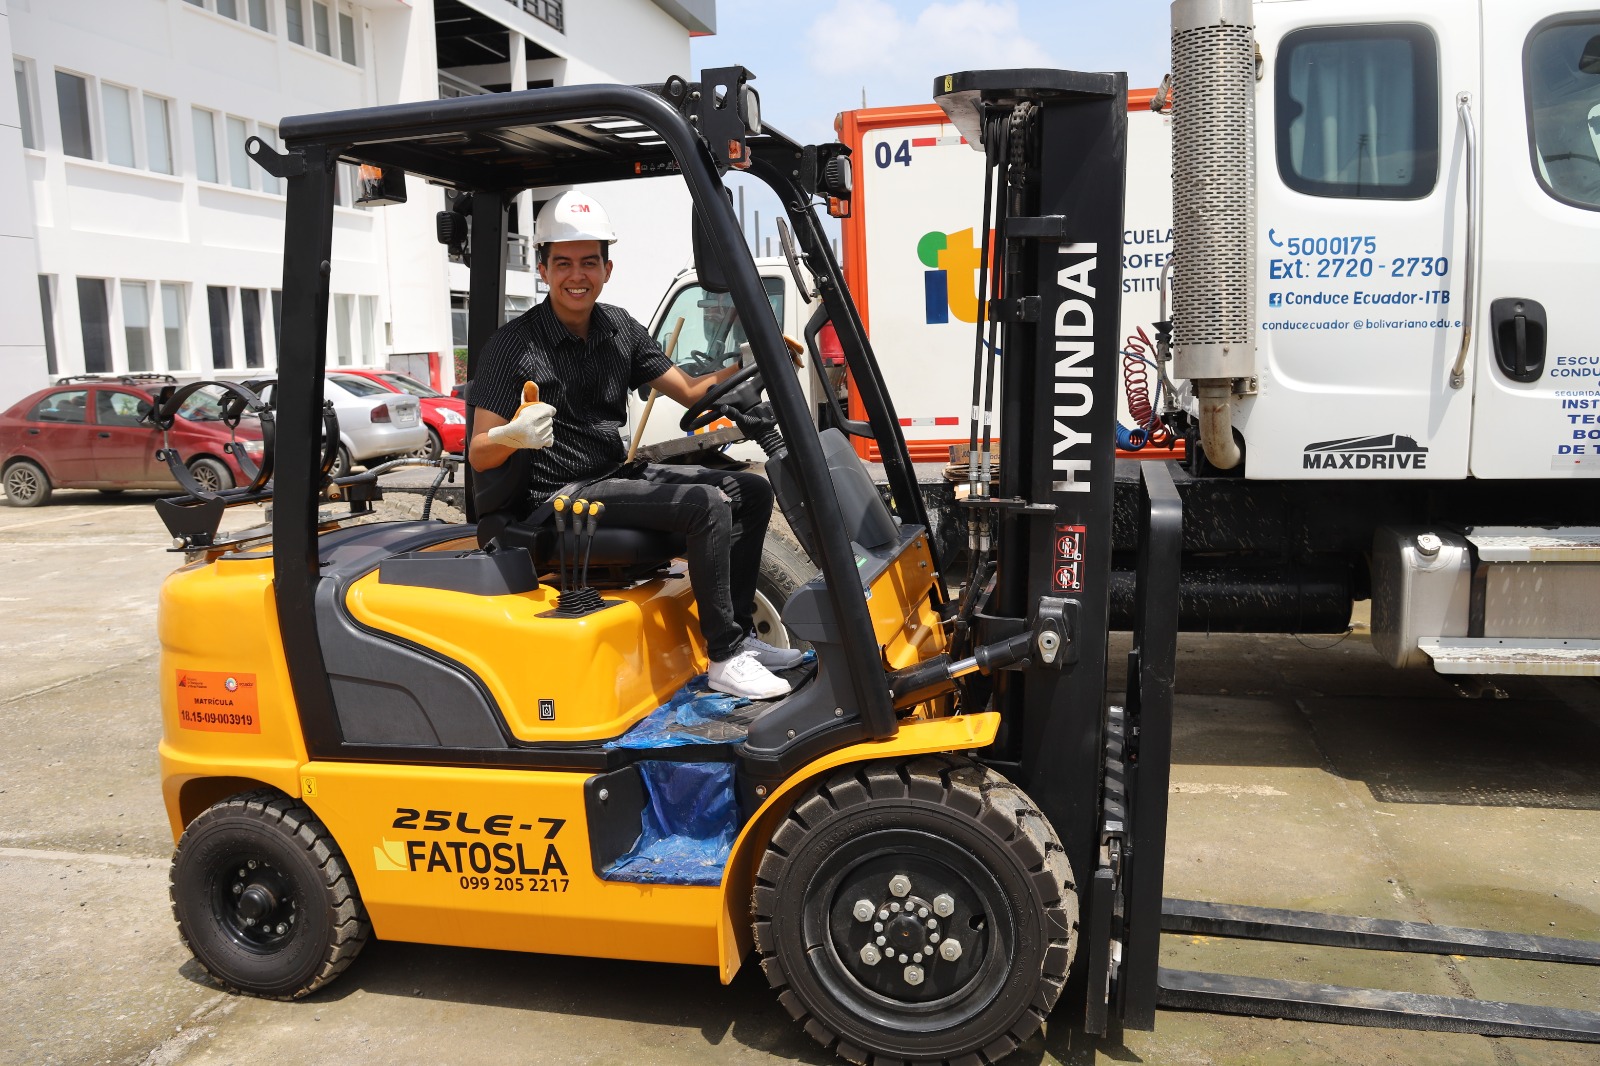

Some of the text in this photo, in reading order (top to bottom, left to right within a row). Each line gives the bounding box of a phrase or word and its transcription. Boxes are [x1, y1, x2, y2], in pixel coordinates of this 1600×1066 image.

[875, 139, 912, 169] 04
[1287, 236, 1377, 256] 5000175
[1269, 258, 1310, 280] Ext:
[1316, 258, 1373, 278] 2720
[1391, 256, 1449, 277] 2730
[1285, 291, 1349, 305] Conduce
[1353, 290, 1450, 305] Ecuador-ITB
[1052, 242, 1098, 493] HYUNDAI
[1558, 444, 1586, 454] DE
[1302, 453, 1427, 469] MAXDRIVE
[194, 698, 234, 706] MATRÍCULA
[181, 709, 253, 725] 18.15-09-003919
[392, 807, 567, 840] 25LE-7
[406, 840, 569, 876] FATOSLA
[459, 876, 570, 893] 099 205 2217
